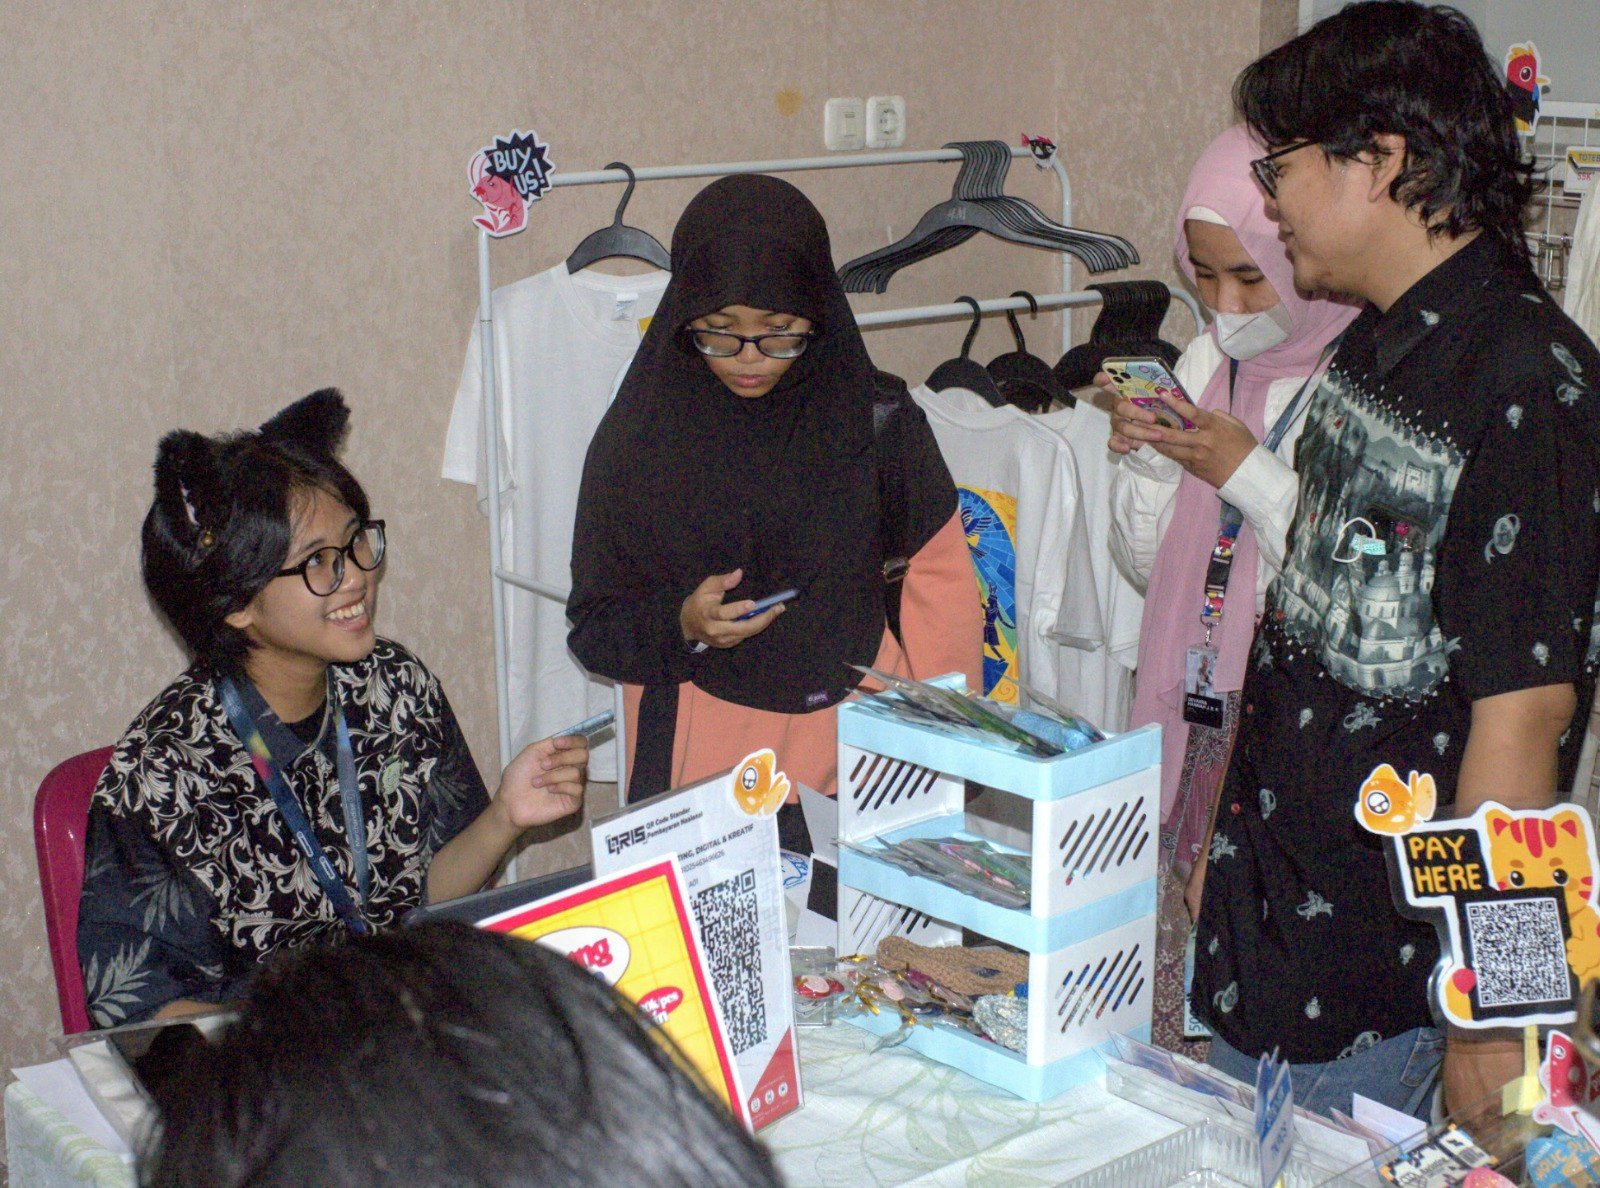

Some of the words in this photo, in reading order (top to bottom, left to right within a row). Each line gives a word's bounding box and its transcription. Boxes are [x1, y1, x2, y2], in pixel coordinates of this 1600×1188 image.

[493, 147, 531, 173] BUY
[513, 158, 545, 195] US!
[606, 825, 646, 855] QRIS
[646, 821, 654, 829] QR
[655, 816, 669, 826] Code
[695, 839, 721, 855] DIGITAL
[728, 823, 754, 841] KREATIF
[1408, 835, 1465, 861] PAY
[1414, 863, 1483, 893] HERE
